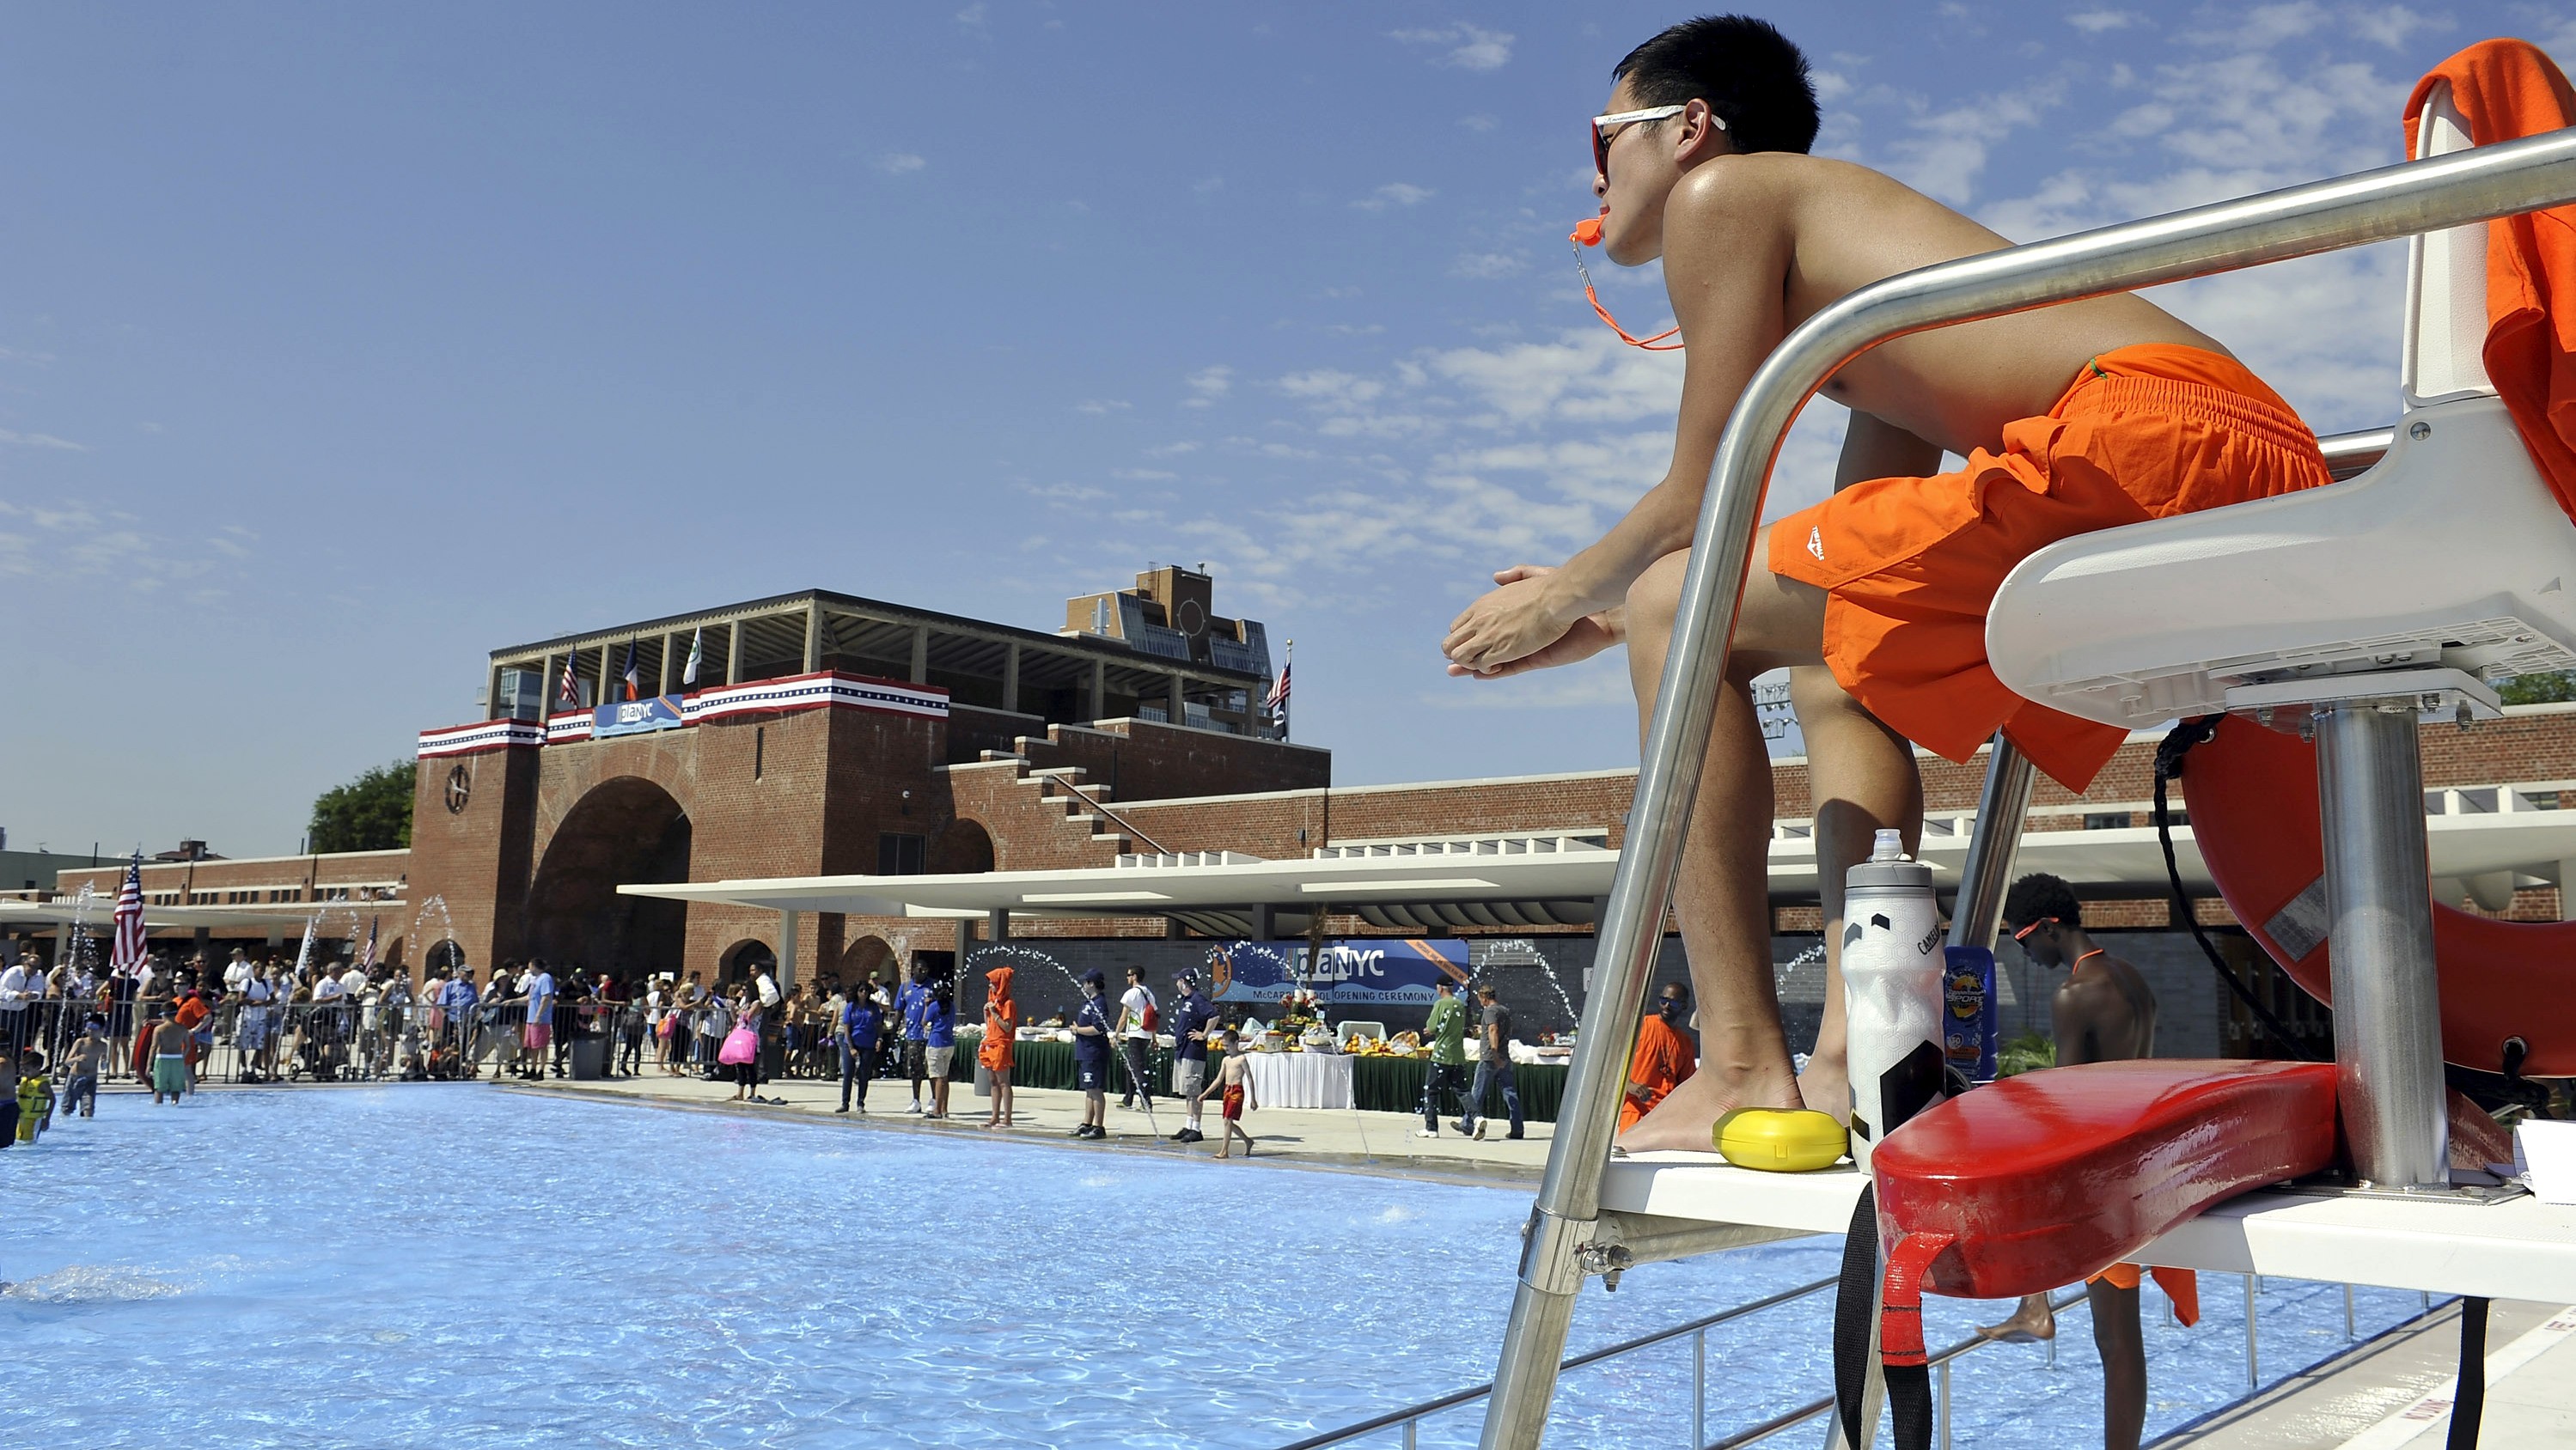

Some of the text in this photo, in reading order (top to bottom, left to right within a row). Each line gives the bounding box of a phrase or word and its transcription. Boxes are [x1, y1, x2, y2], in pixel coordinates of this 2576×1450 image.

[1297, 949, 1384, 978] paNYC
[1334, 991, 1376, 1001] OPENING
[1378, 991, 1435, 1002] CEREMONY
